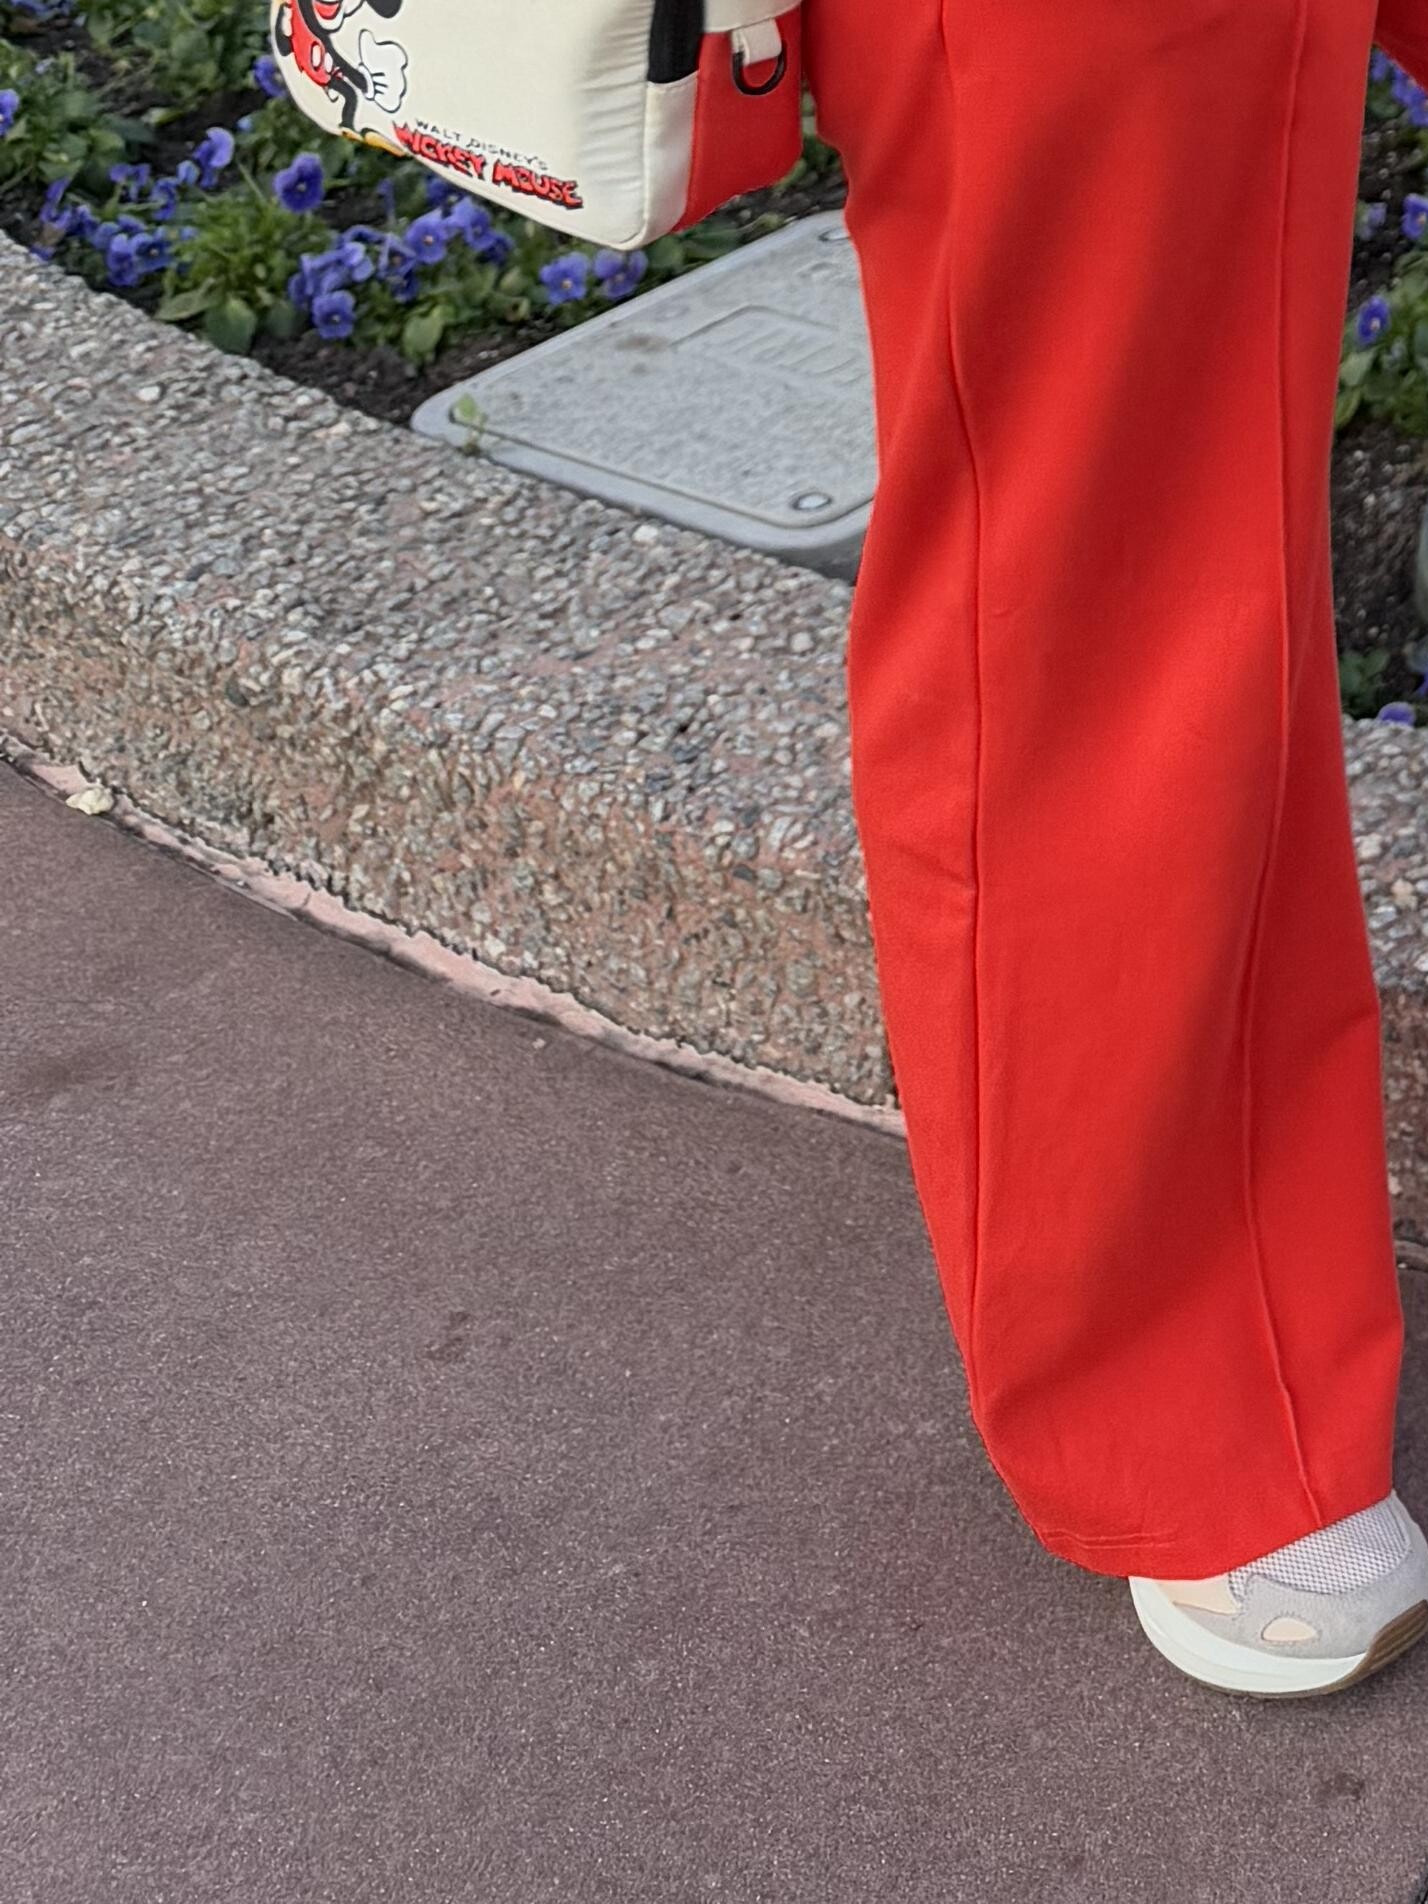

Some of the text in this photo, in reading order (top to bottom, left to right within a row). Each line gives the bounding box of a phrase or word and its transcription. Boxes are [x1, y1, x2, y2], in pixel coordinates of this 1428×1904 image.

[415, 118, 463, 141] WALT
[391, 121, 584, 210] MICKEY MOUSE
